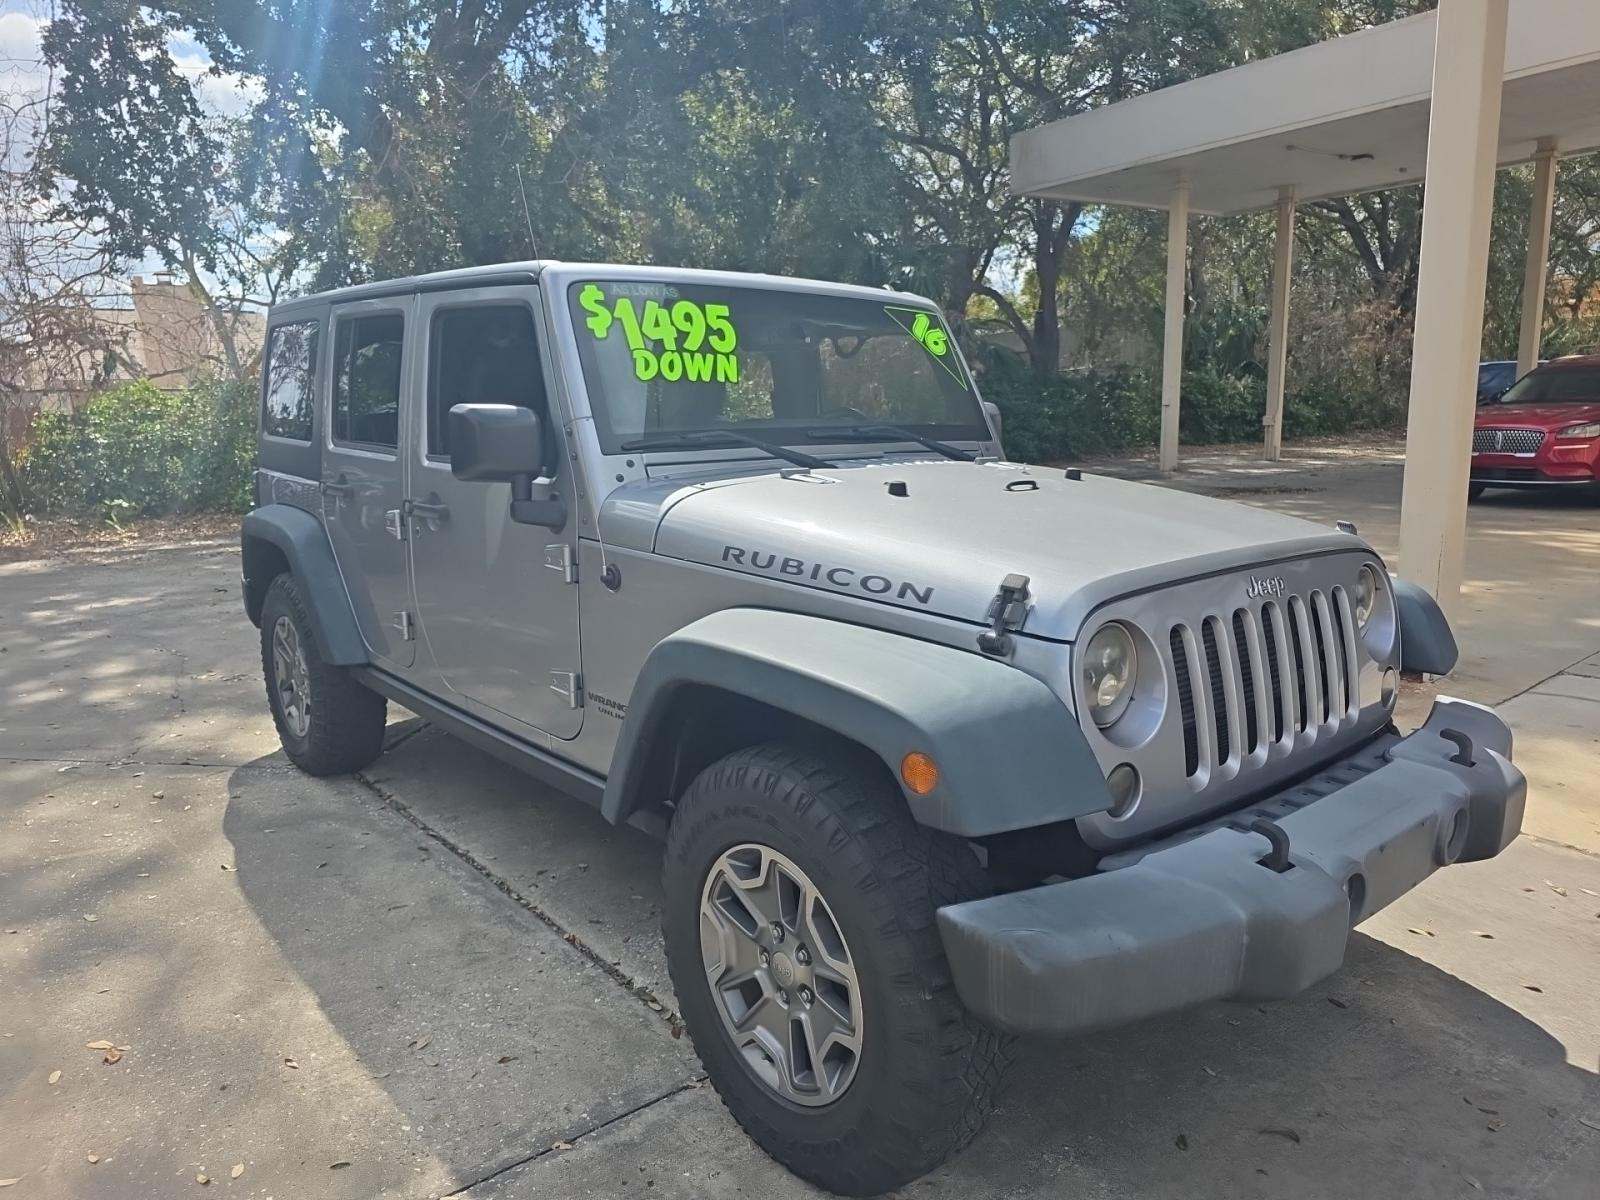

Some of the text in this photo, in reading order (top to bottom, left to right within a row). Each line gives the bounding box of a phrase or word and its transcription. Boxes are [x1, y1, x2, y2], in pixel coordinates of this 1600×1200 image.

[579, 284, 737, 354] $1495
[911, 313, 949, 356] 16
[632, 350, 739, 384] DOWN
[721, 545, 935, 604] RUBICON
[1247, 575, 1285, 599] Jeep
